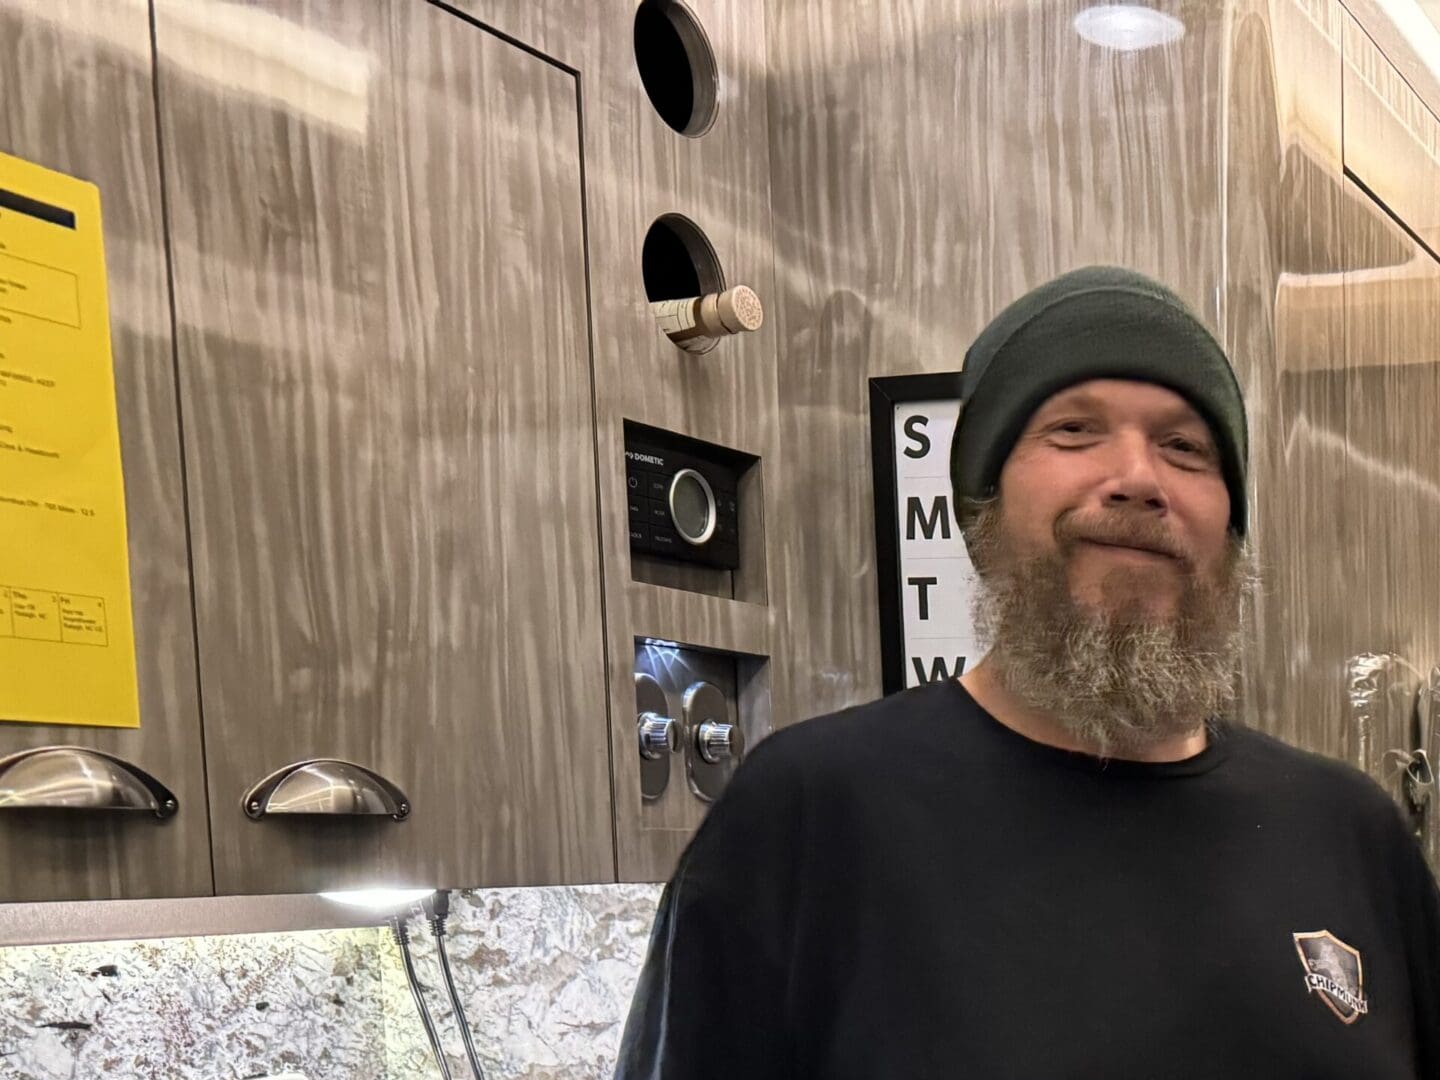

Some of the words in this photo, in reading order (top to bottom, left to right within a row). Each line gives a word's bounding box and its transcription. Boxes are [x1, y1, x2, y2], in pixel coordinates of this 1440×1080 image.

[903, 415, 931, 459] S
[634, 453, 664, 466] DOMETIC
[906, 495, 951, 540] M
[908, 577, 937, 620] T
[912, 656, 967, 688] W
[1308, 975, 1366, 1012] CHIPMUNK
